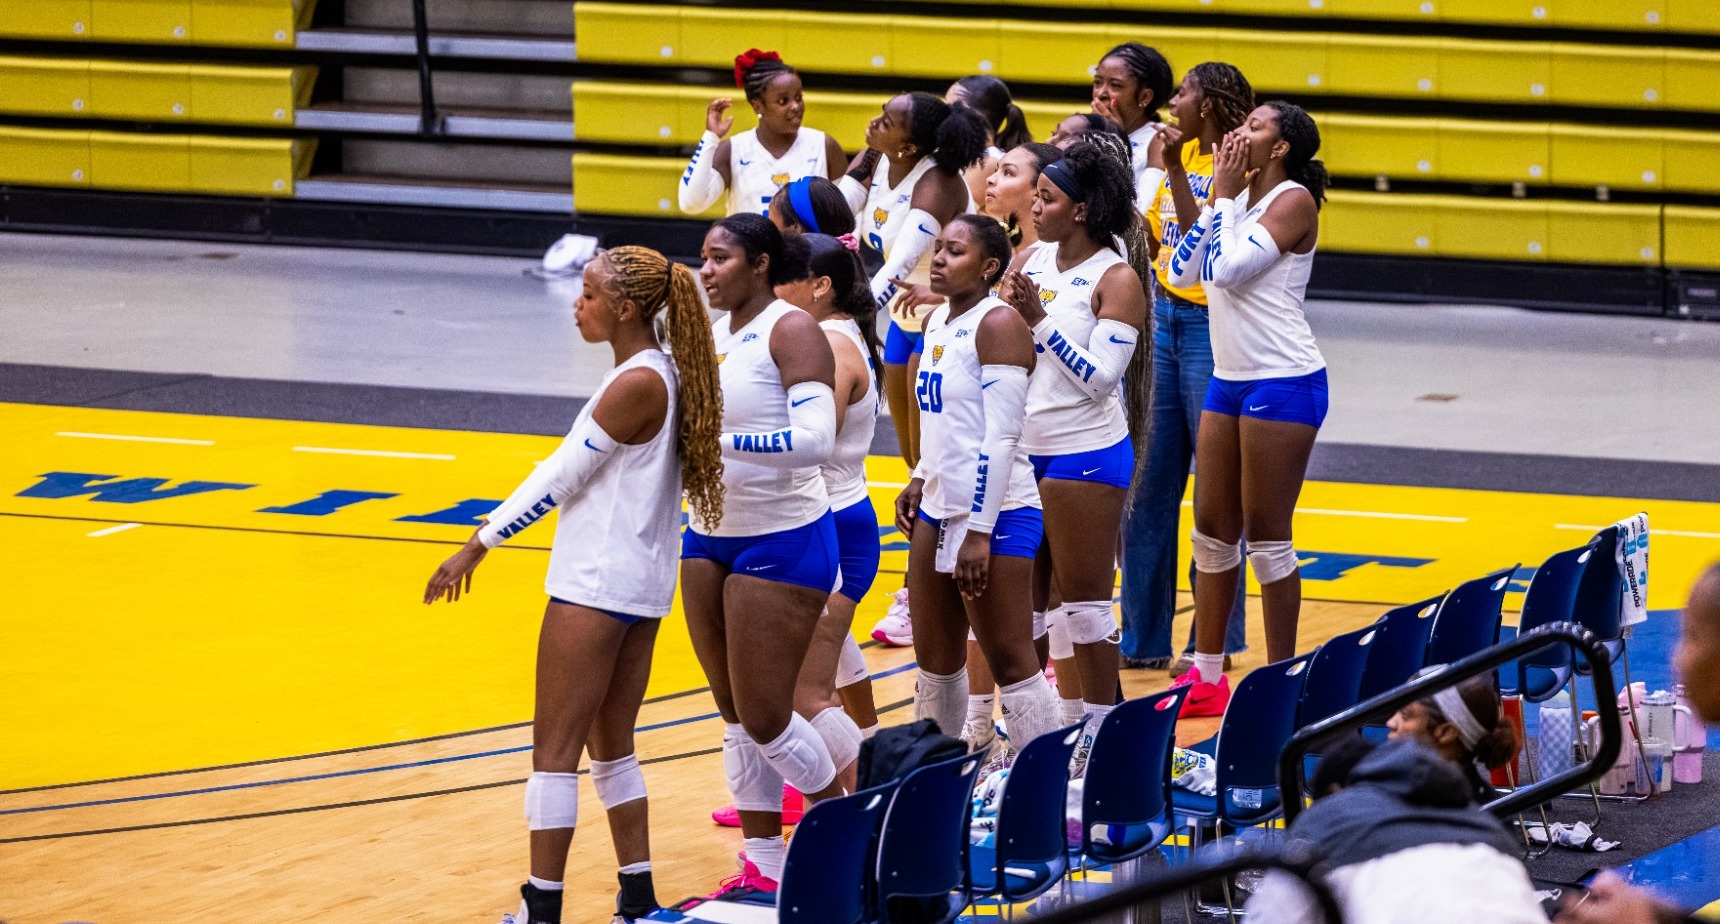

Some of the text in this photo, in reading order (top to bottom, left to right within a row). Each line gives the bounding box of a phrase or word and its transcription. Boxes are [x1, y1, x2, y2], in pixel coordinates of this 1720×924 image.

[1171, 219, 1206, 277] FORT
[1046, 329, 1097, 384] VALLEY
[917, 370, 943, 413] 20
[732, 430, 794, 453] VALLEY
[970, 453, 989, 513] VALLEY
[496, 493, 558, 539] VALLEY
[1624, 558, 1641, 608] POWERADE
